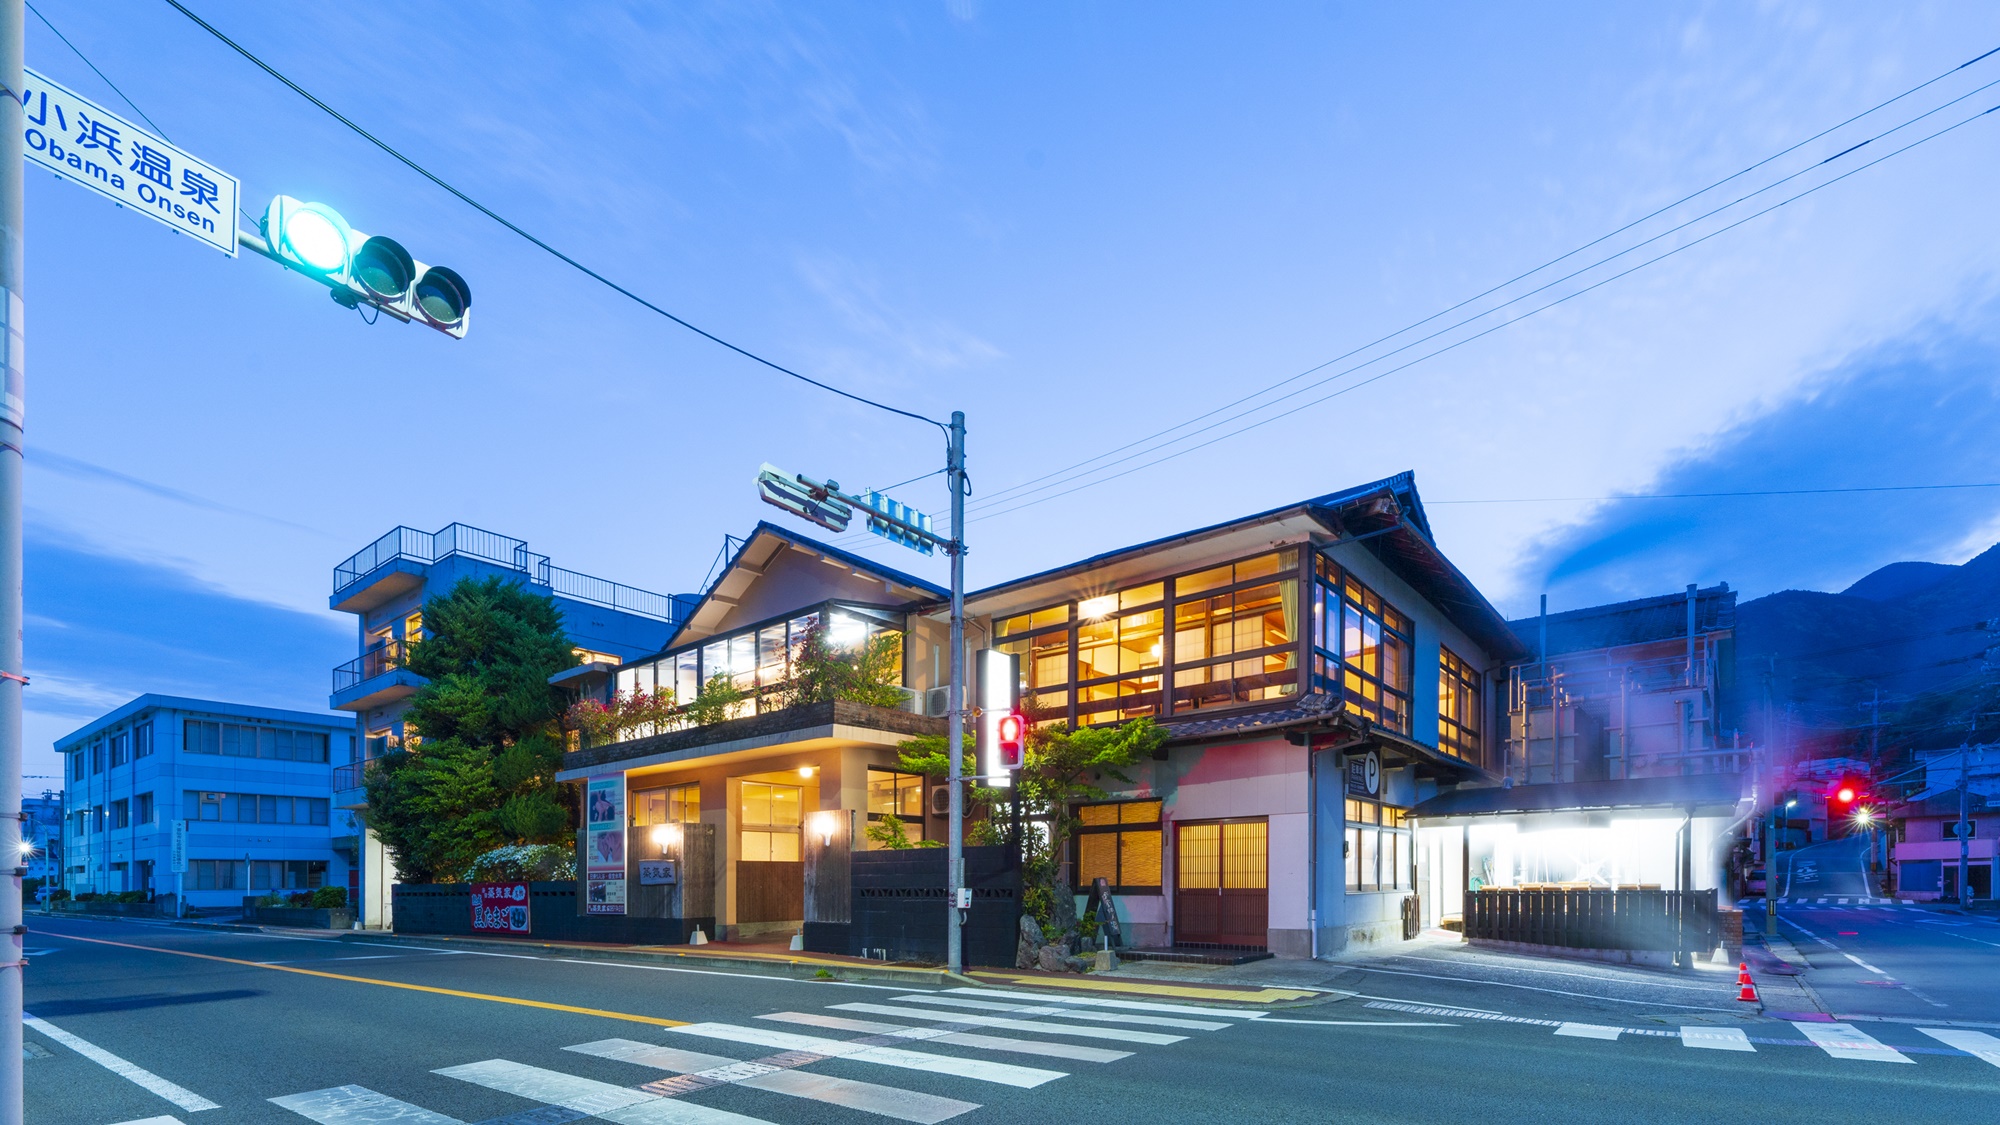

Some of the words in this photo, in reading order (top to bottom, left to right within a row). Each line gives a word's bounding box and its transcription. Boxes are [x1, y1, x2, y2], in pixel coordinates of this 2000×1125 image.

[24, 89, 221, 214] 小浜温泉
[25, 128, 125, 191] Obama
[137, 183, 215, 233] Onsen
[1369, 758, 1376, 788] P
[643, 867, 672, 878] 蒸気家
